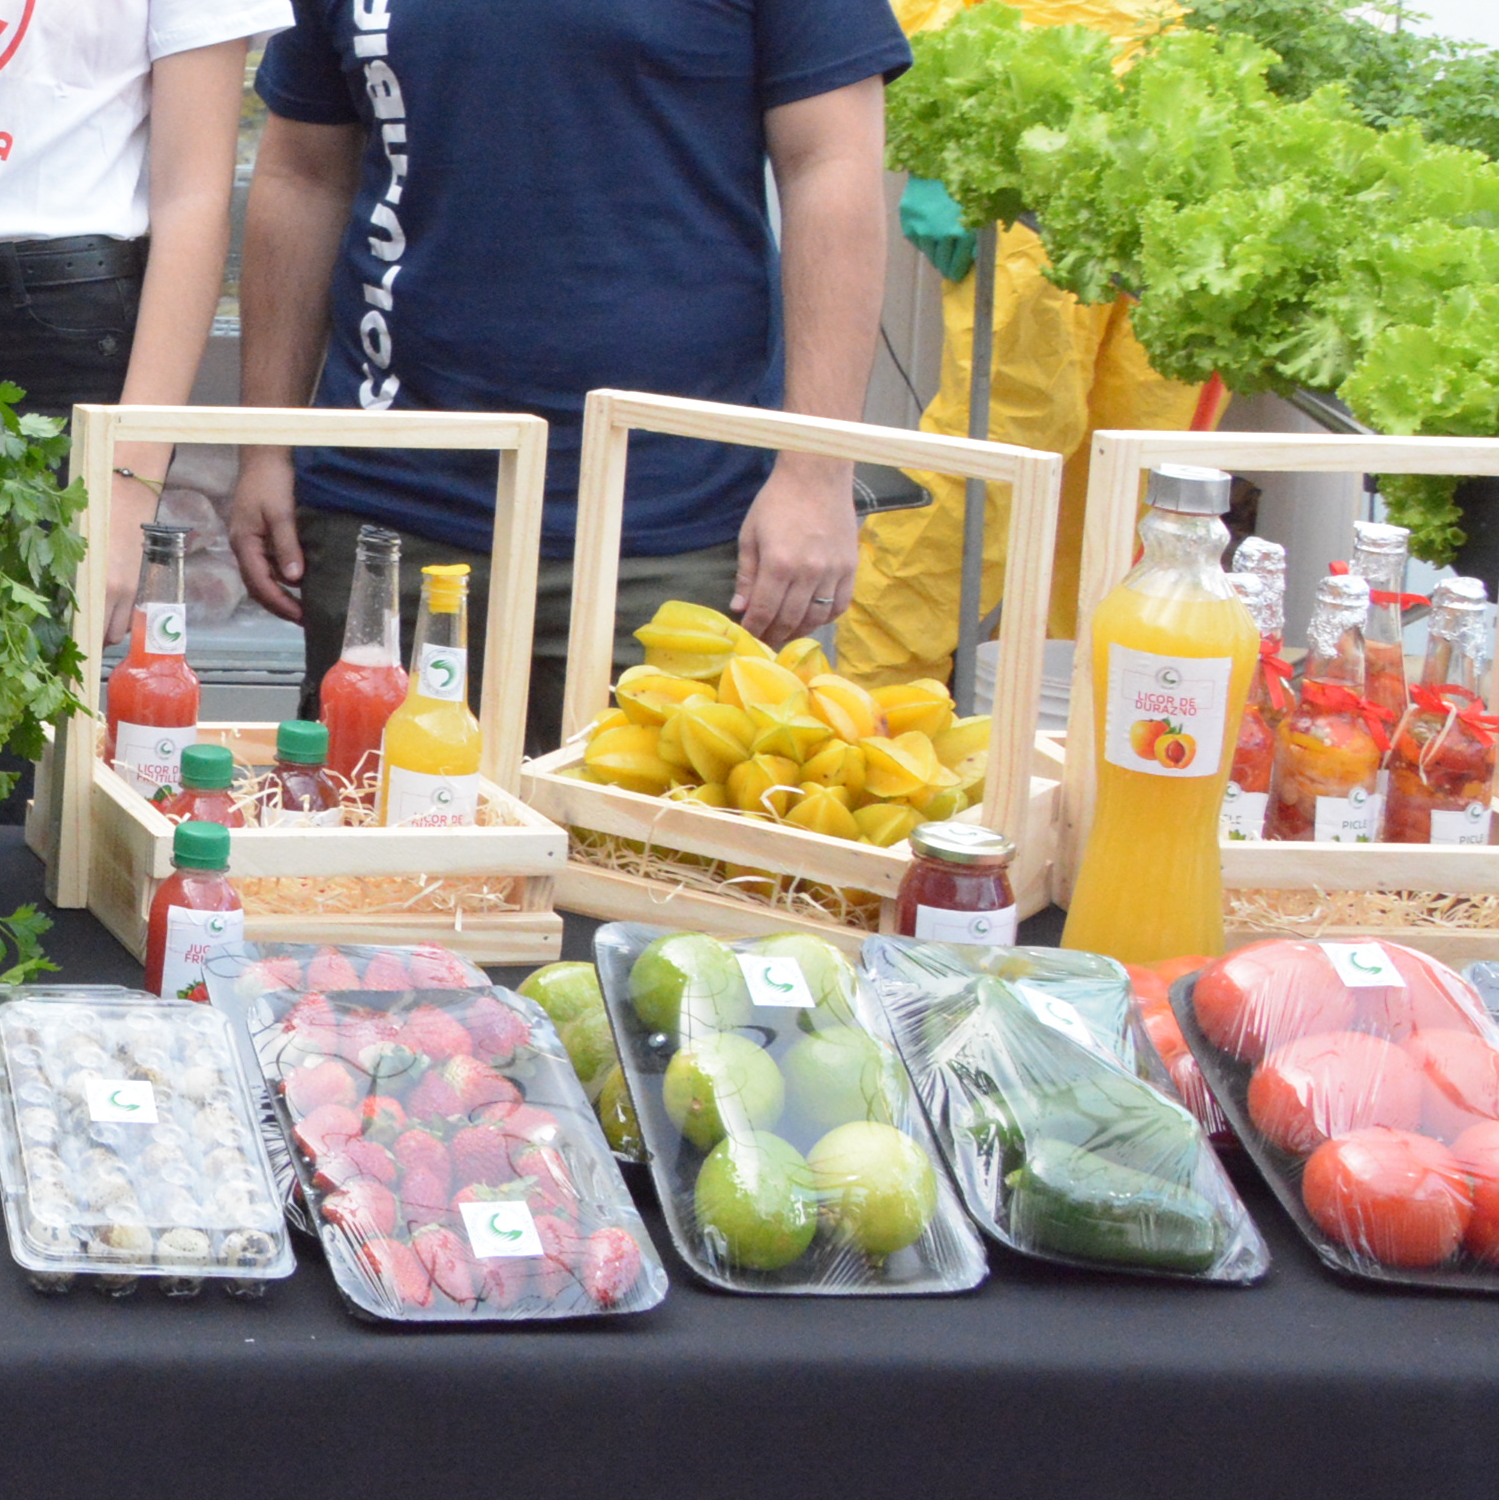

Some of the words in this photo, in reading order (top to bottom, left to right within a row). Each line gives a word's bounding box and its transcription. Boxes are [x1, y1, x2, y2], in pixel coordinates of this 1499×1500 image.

[1137, 690, 1175, 706] LICOR
[1180, 697, 1196, 708] DE
[1135, 700, 1197, 717] DURAZNO
[137, 763, 170, 775] LICOR
